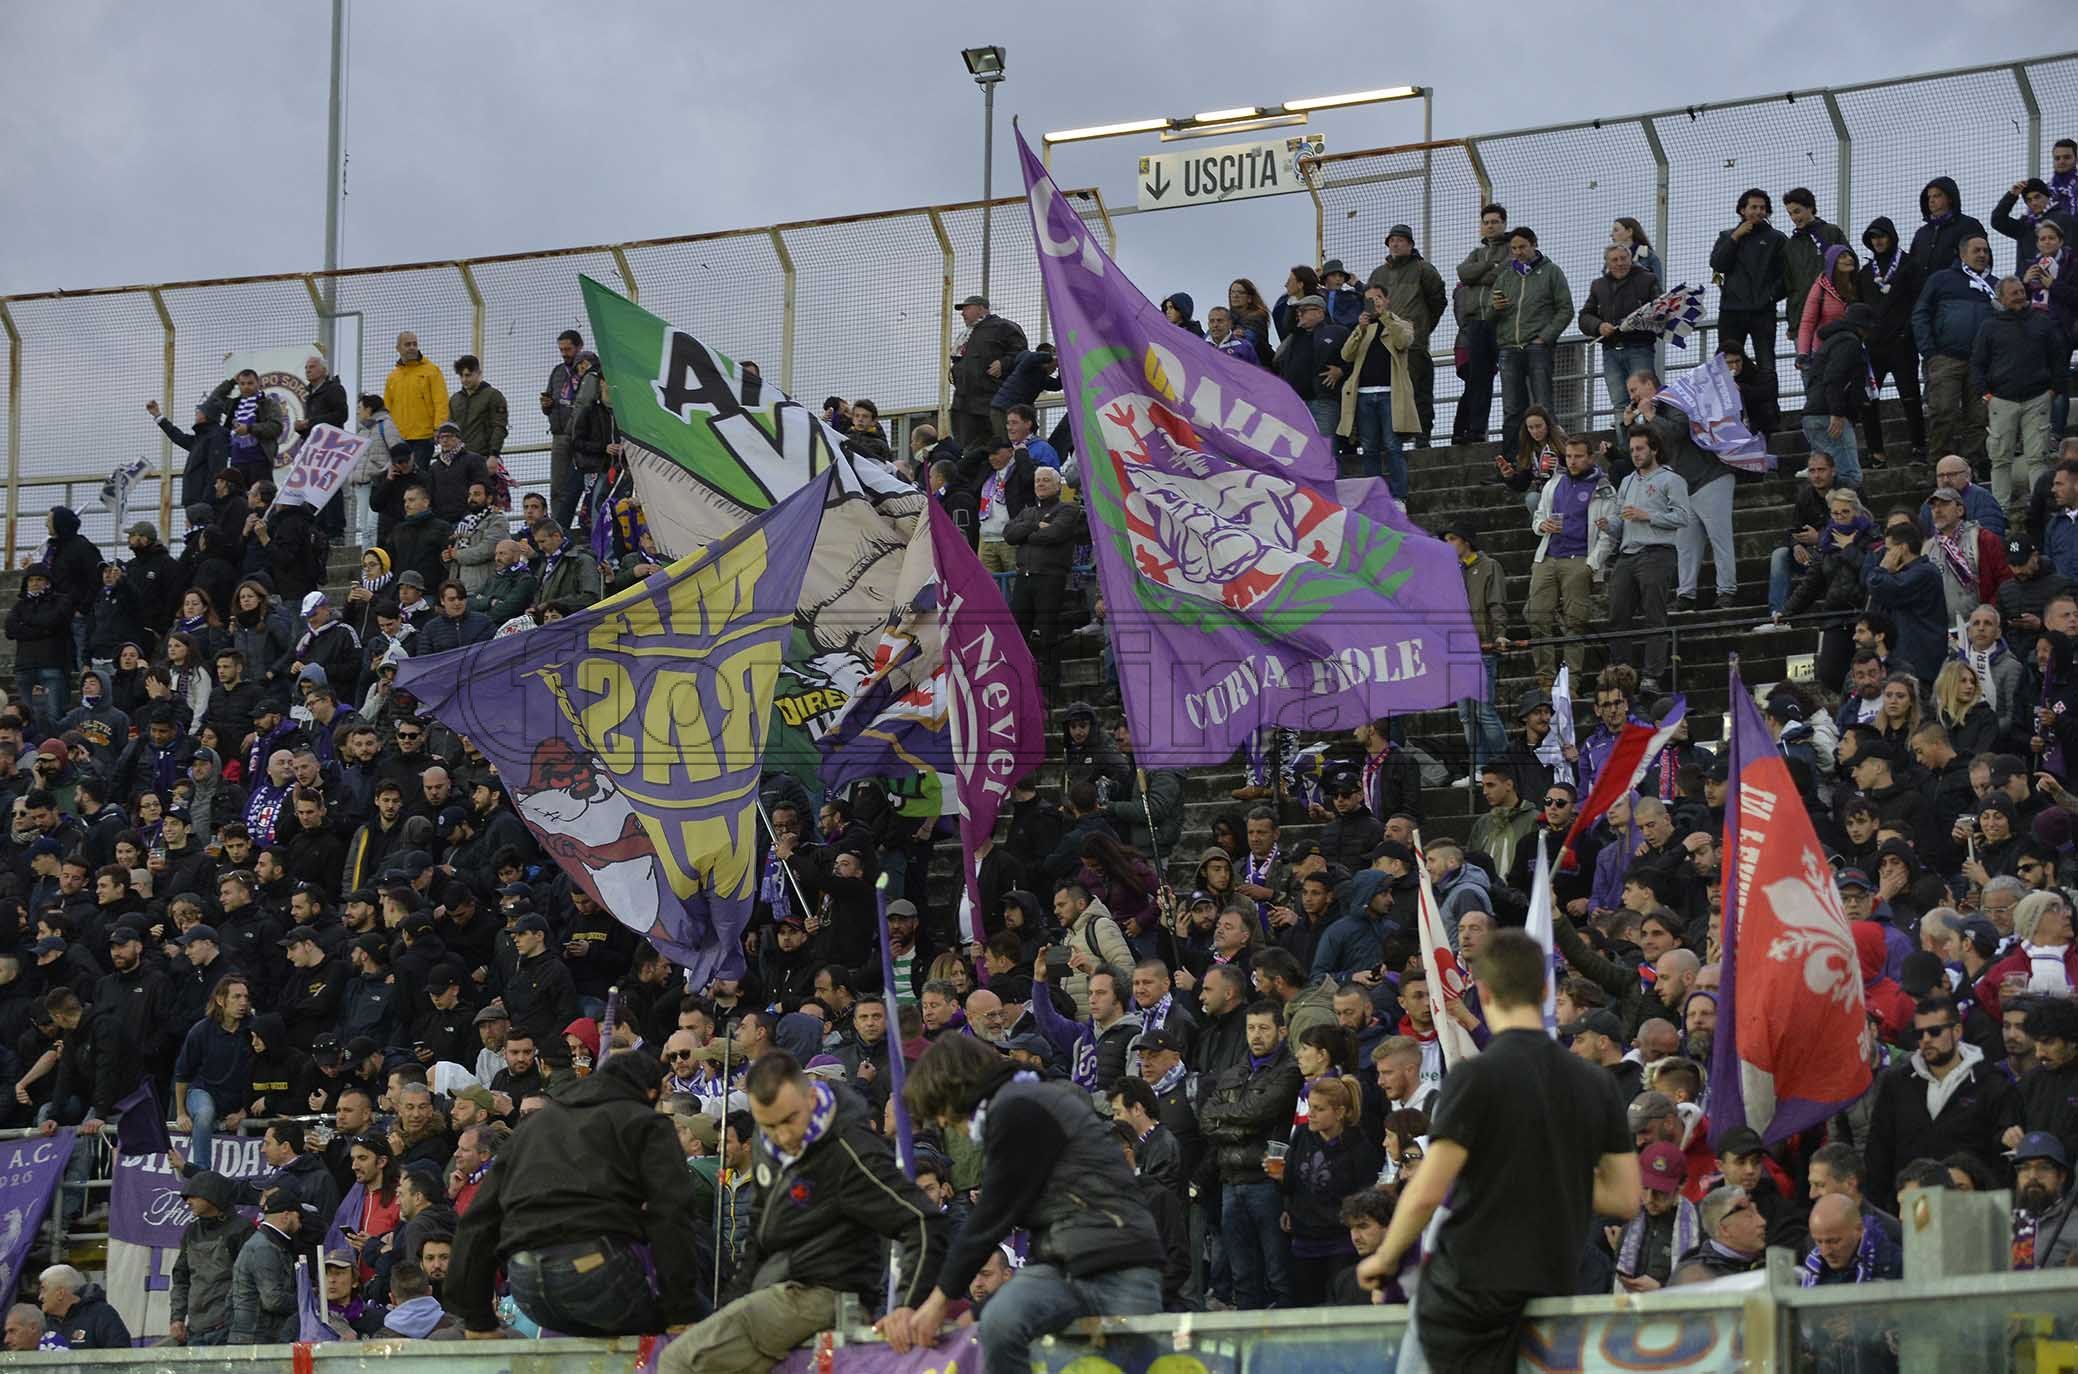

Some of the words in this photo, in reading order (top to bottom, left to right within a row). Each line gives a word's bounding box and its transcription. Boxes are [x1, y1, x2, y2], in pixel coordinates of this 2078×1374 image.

[1184, 149, 1278, 197] USCITA
[960, 623, 1017, 806] Never
[1184, 654, 1290, 730] CURVA
